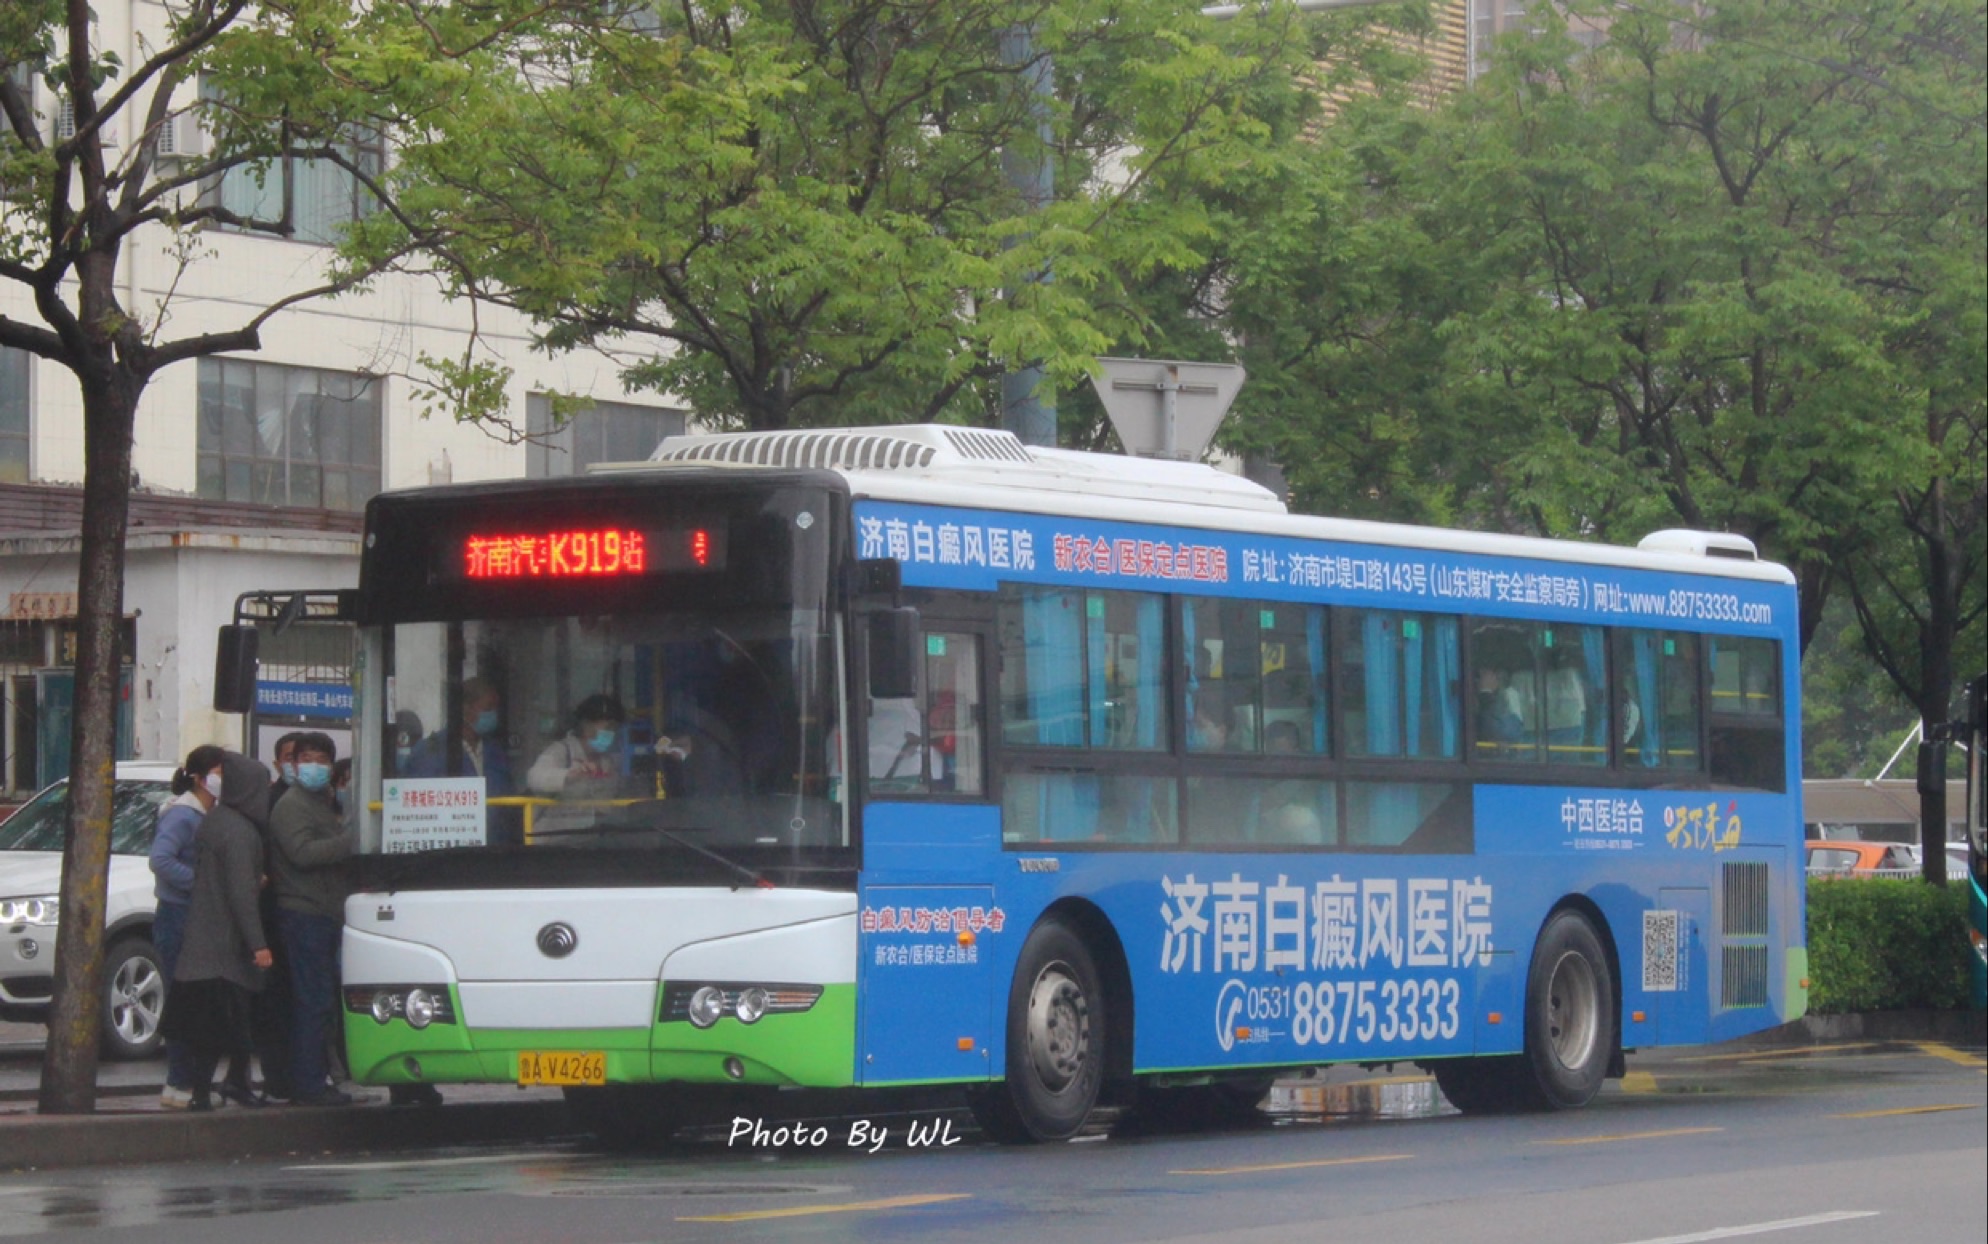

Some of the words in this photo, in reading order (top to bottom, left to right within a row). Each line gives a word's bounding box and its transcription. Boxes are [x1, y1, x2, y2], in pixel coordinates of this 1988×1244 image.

[859, 516, 1036, 571] 济南白癜风医院
[1052, 533, 1228, 583] 新农合/医保定点医院
[1561, 796, 1644, 835] 中西医结合
[861, 905, 1006, 934] 白癜风防治倡导者
[1160, 873, 1494, 974] 济南白癜风医院
[1247, 985, 1290, 1020] 0531
[1292, 978, 1460, 1046] 88753333
